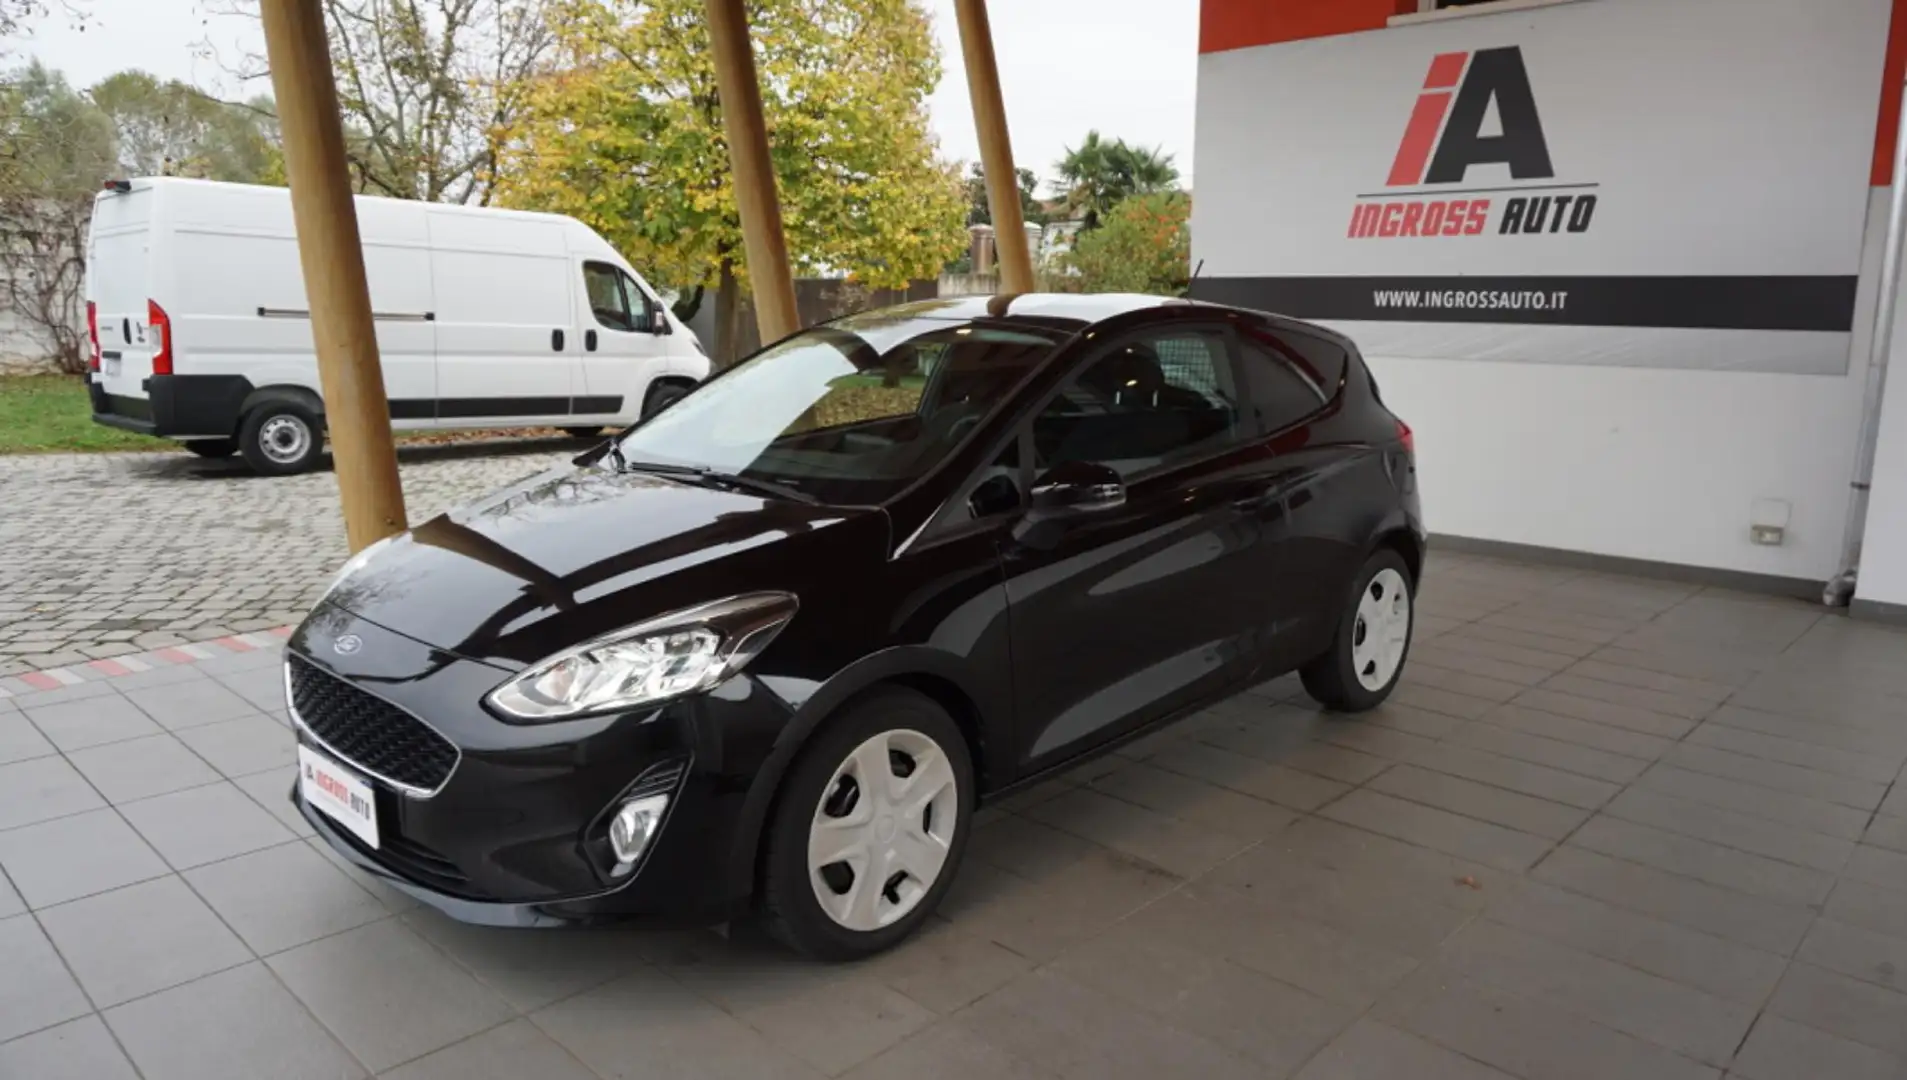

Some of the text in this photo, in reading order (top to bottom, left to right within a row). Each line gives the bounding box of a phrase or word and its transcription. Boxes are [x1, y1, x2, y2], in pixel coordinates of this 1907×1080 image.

[1347, 194, 1597, 238] INGROSS AUTO
[1373, 290, 1568, 310] WWW.INGROSSAUTO.IT
